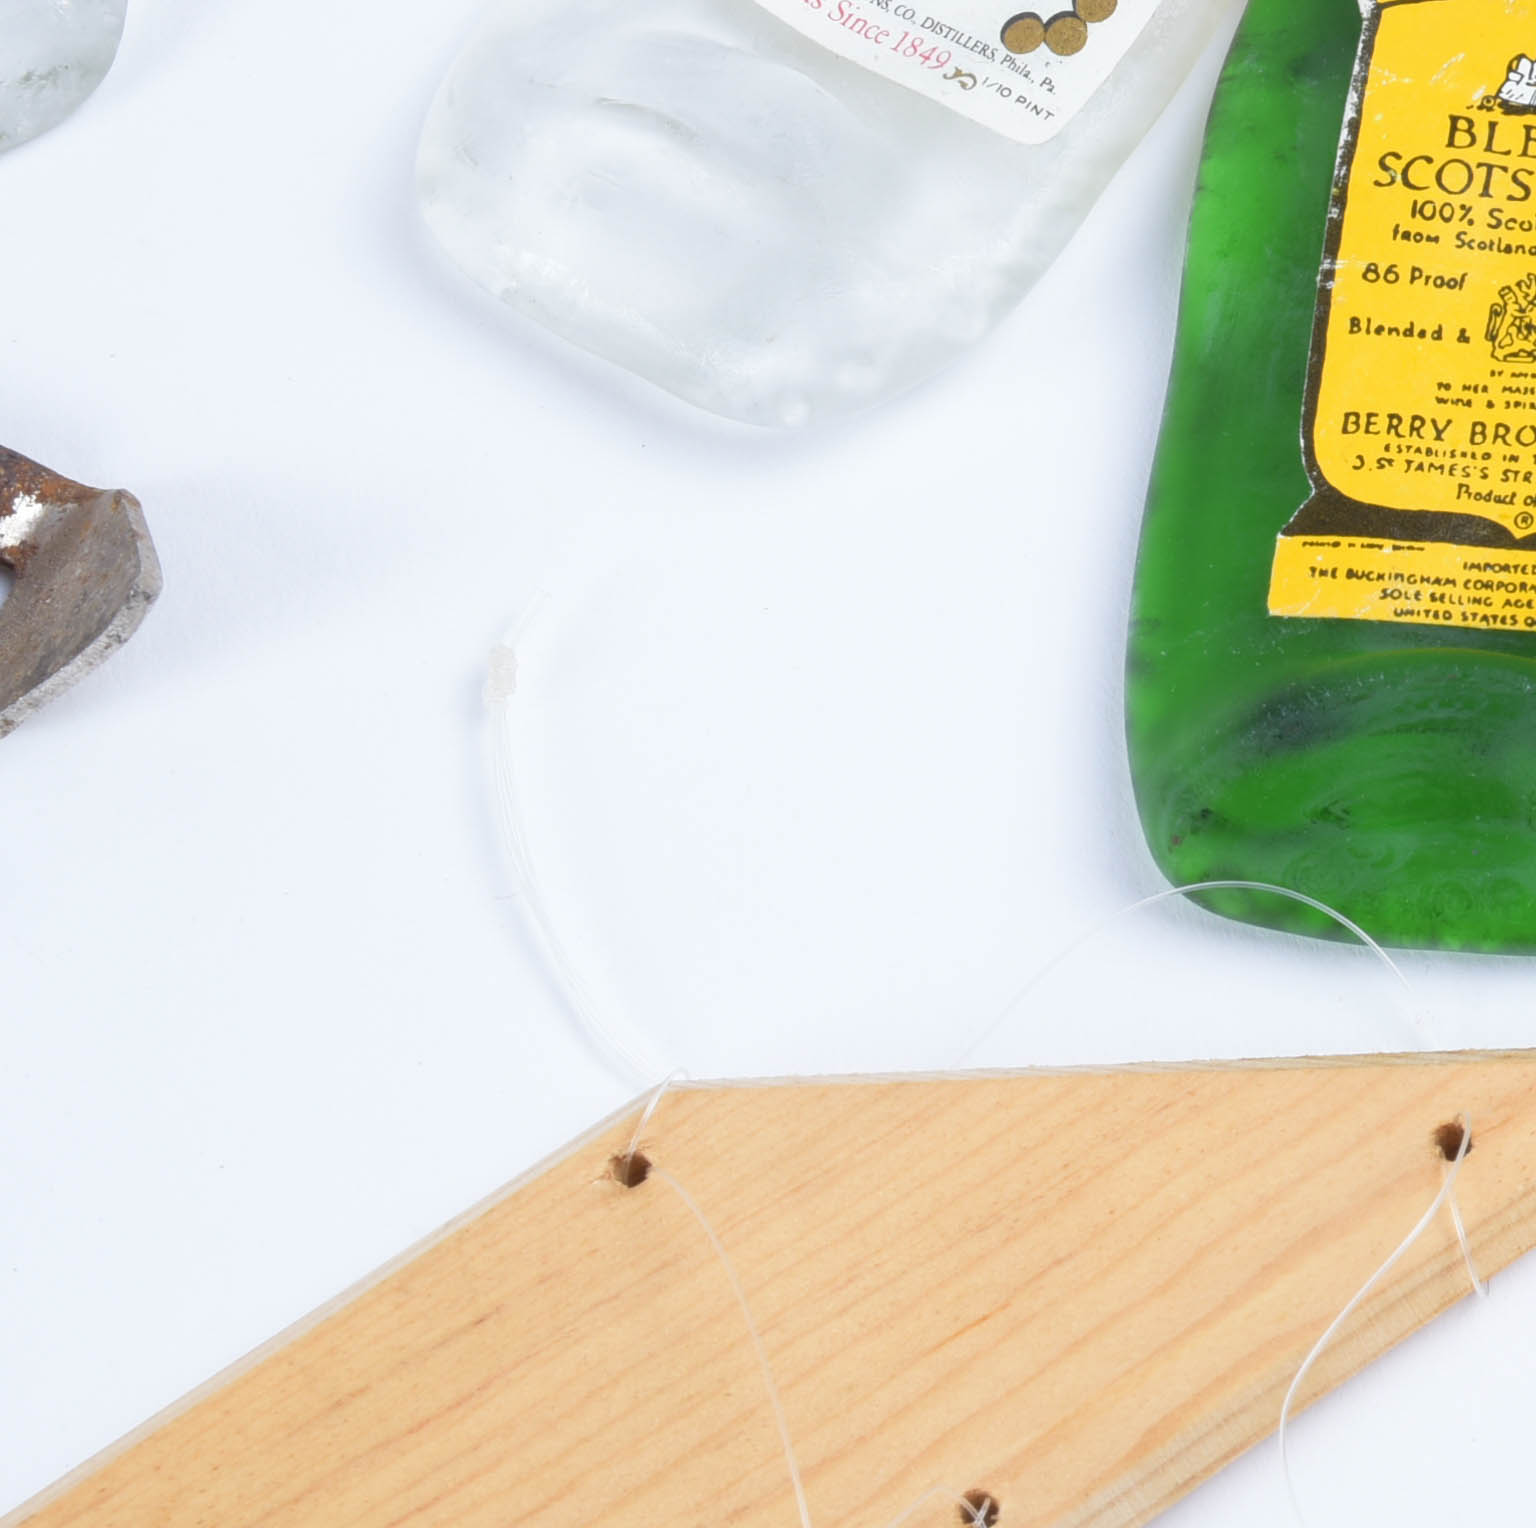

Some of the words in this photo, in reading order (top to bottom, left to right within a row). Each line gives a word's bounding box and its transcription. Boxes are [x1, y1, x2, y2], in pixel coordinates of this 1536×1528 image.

[826, 0, 891, 45] Since
[889, 30, 952, 77] 1849
[1014, 94, 1055, 121] PINT
[1372, 151, 1535, 202] SCOTS
[1410, 199, 1475, 226] 100%
[1392, 223, 1440, 245] from
[1361, 262, 1400, 285] 86
[1409, 265, 1469, 291] Proof
[1348, 315, 1444, 342] Blended
[1456, 327, 1471, 345] &
[1341, 411, 1453, 442] BERRY
[1455, 482, 1518, 506] Product
